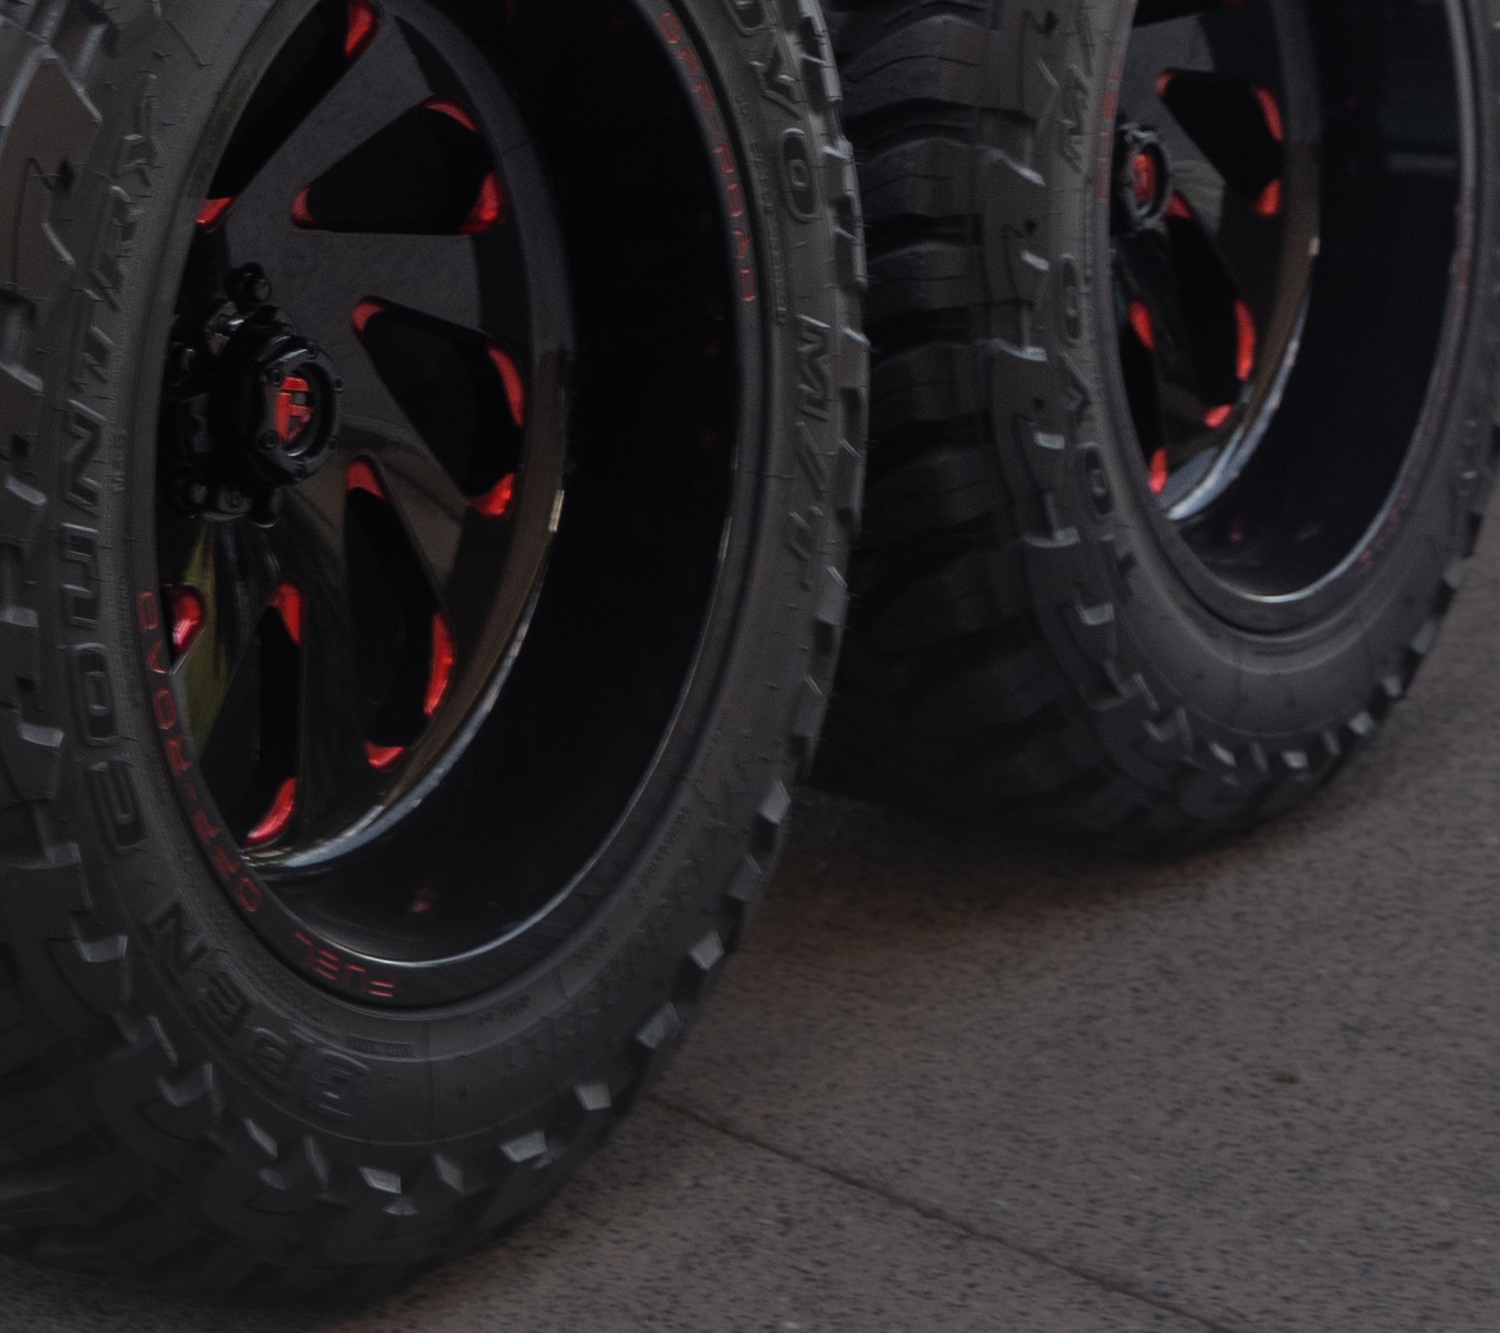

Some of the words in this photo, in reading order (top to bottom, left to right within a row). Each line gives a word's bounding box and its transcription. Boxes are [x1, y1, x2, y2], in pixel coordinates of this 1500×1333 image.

[659, 11, 759, 304] OFF-ROAD
[58, 71, 152, 855] COUNTRY
[137, 590, 262, 914] OFF-ROAD
[294, 931, 396, 999] FUEL
